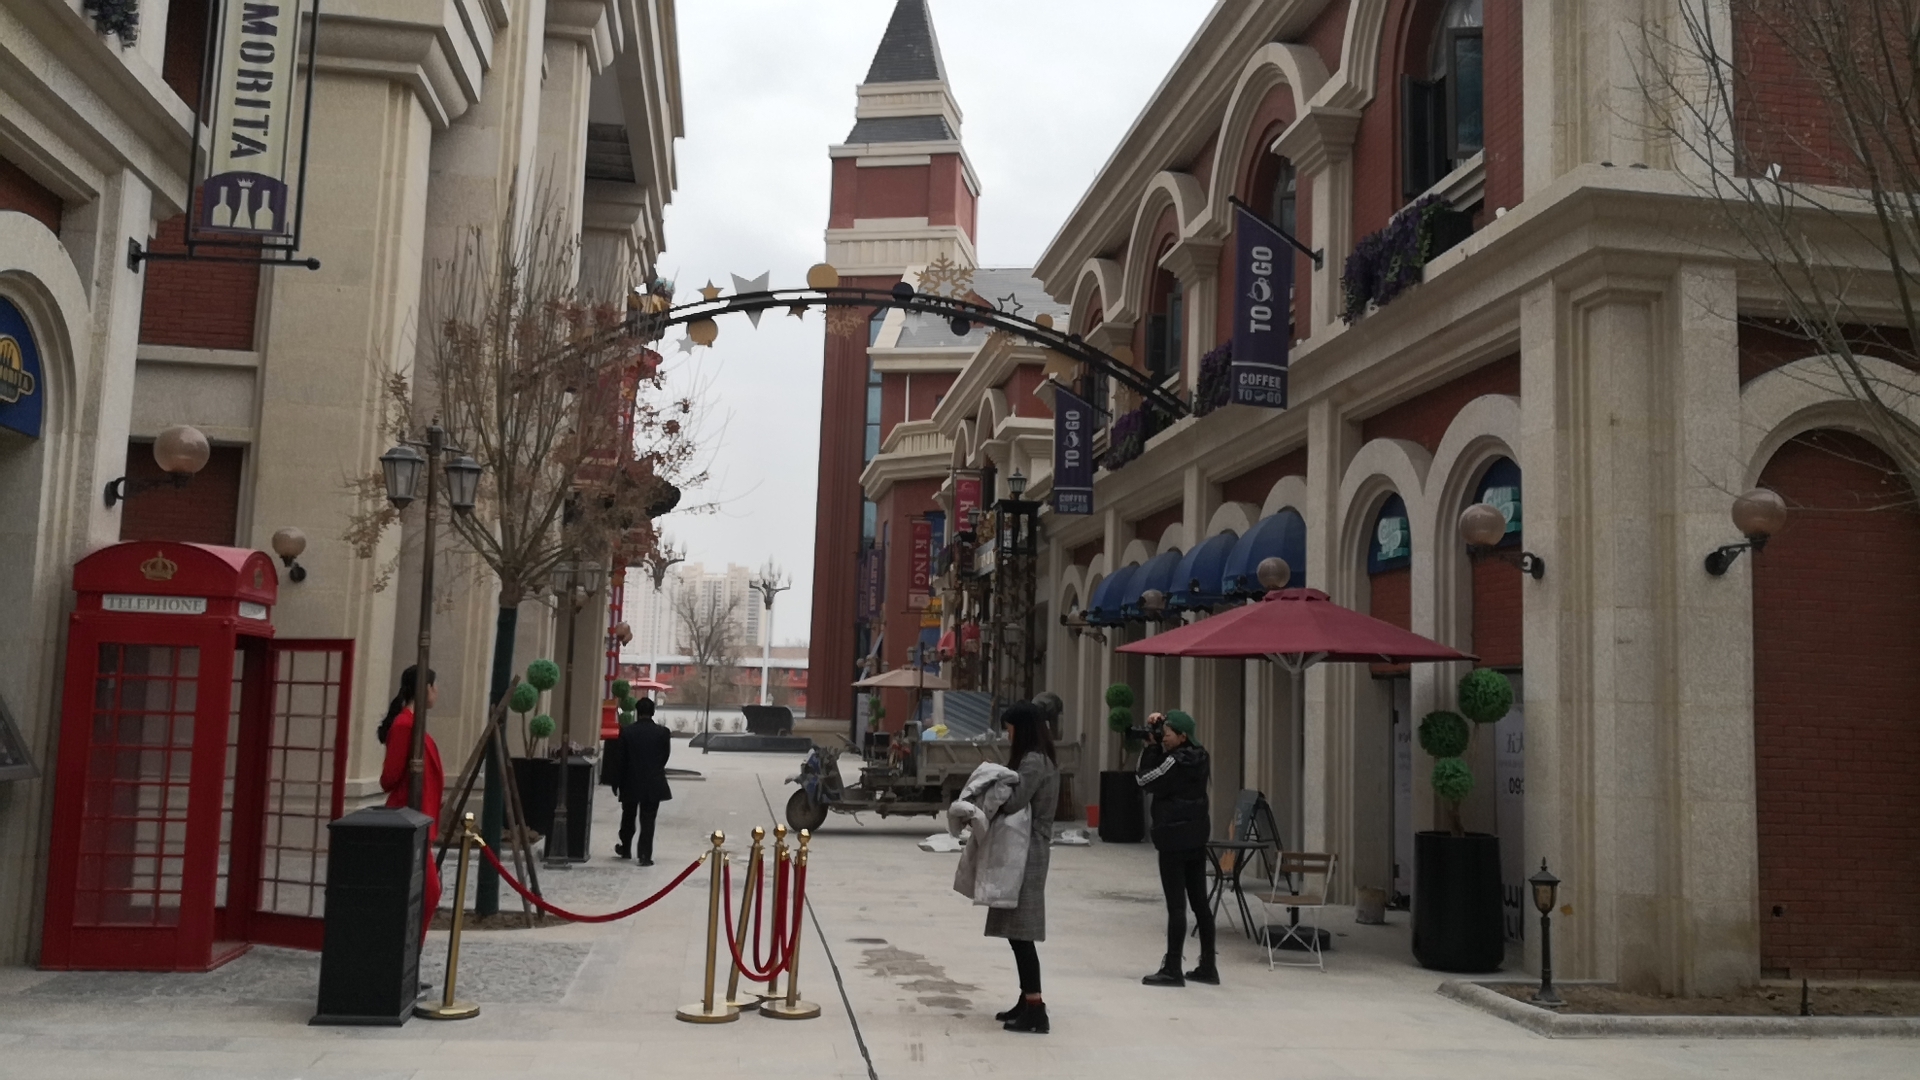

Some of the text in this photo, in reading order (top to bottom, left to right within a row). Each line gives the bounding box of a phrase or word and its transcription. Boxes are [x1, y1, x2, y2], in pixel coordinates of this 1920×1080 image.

[230, 2, 280, 159] MORITA
[1250, 245, 1274, 334] TO GO
[1238, 388, 1282, 405] TO GO
[1239, 372, 1282, 389] COFFEE
[1064, 409, 1080, 469] TO GO
[914, 539, 928, 585] KING
[105, 596, 203, 613] TELEPHONE
